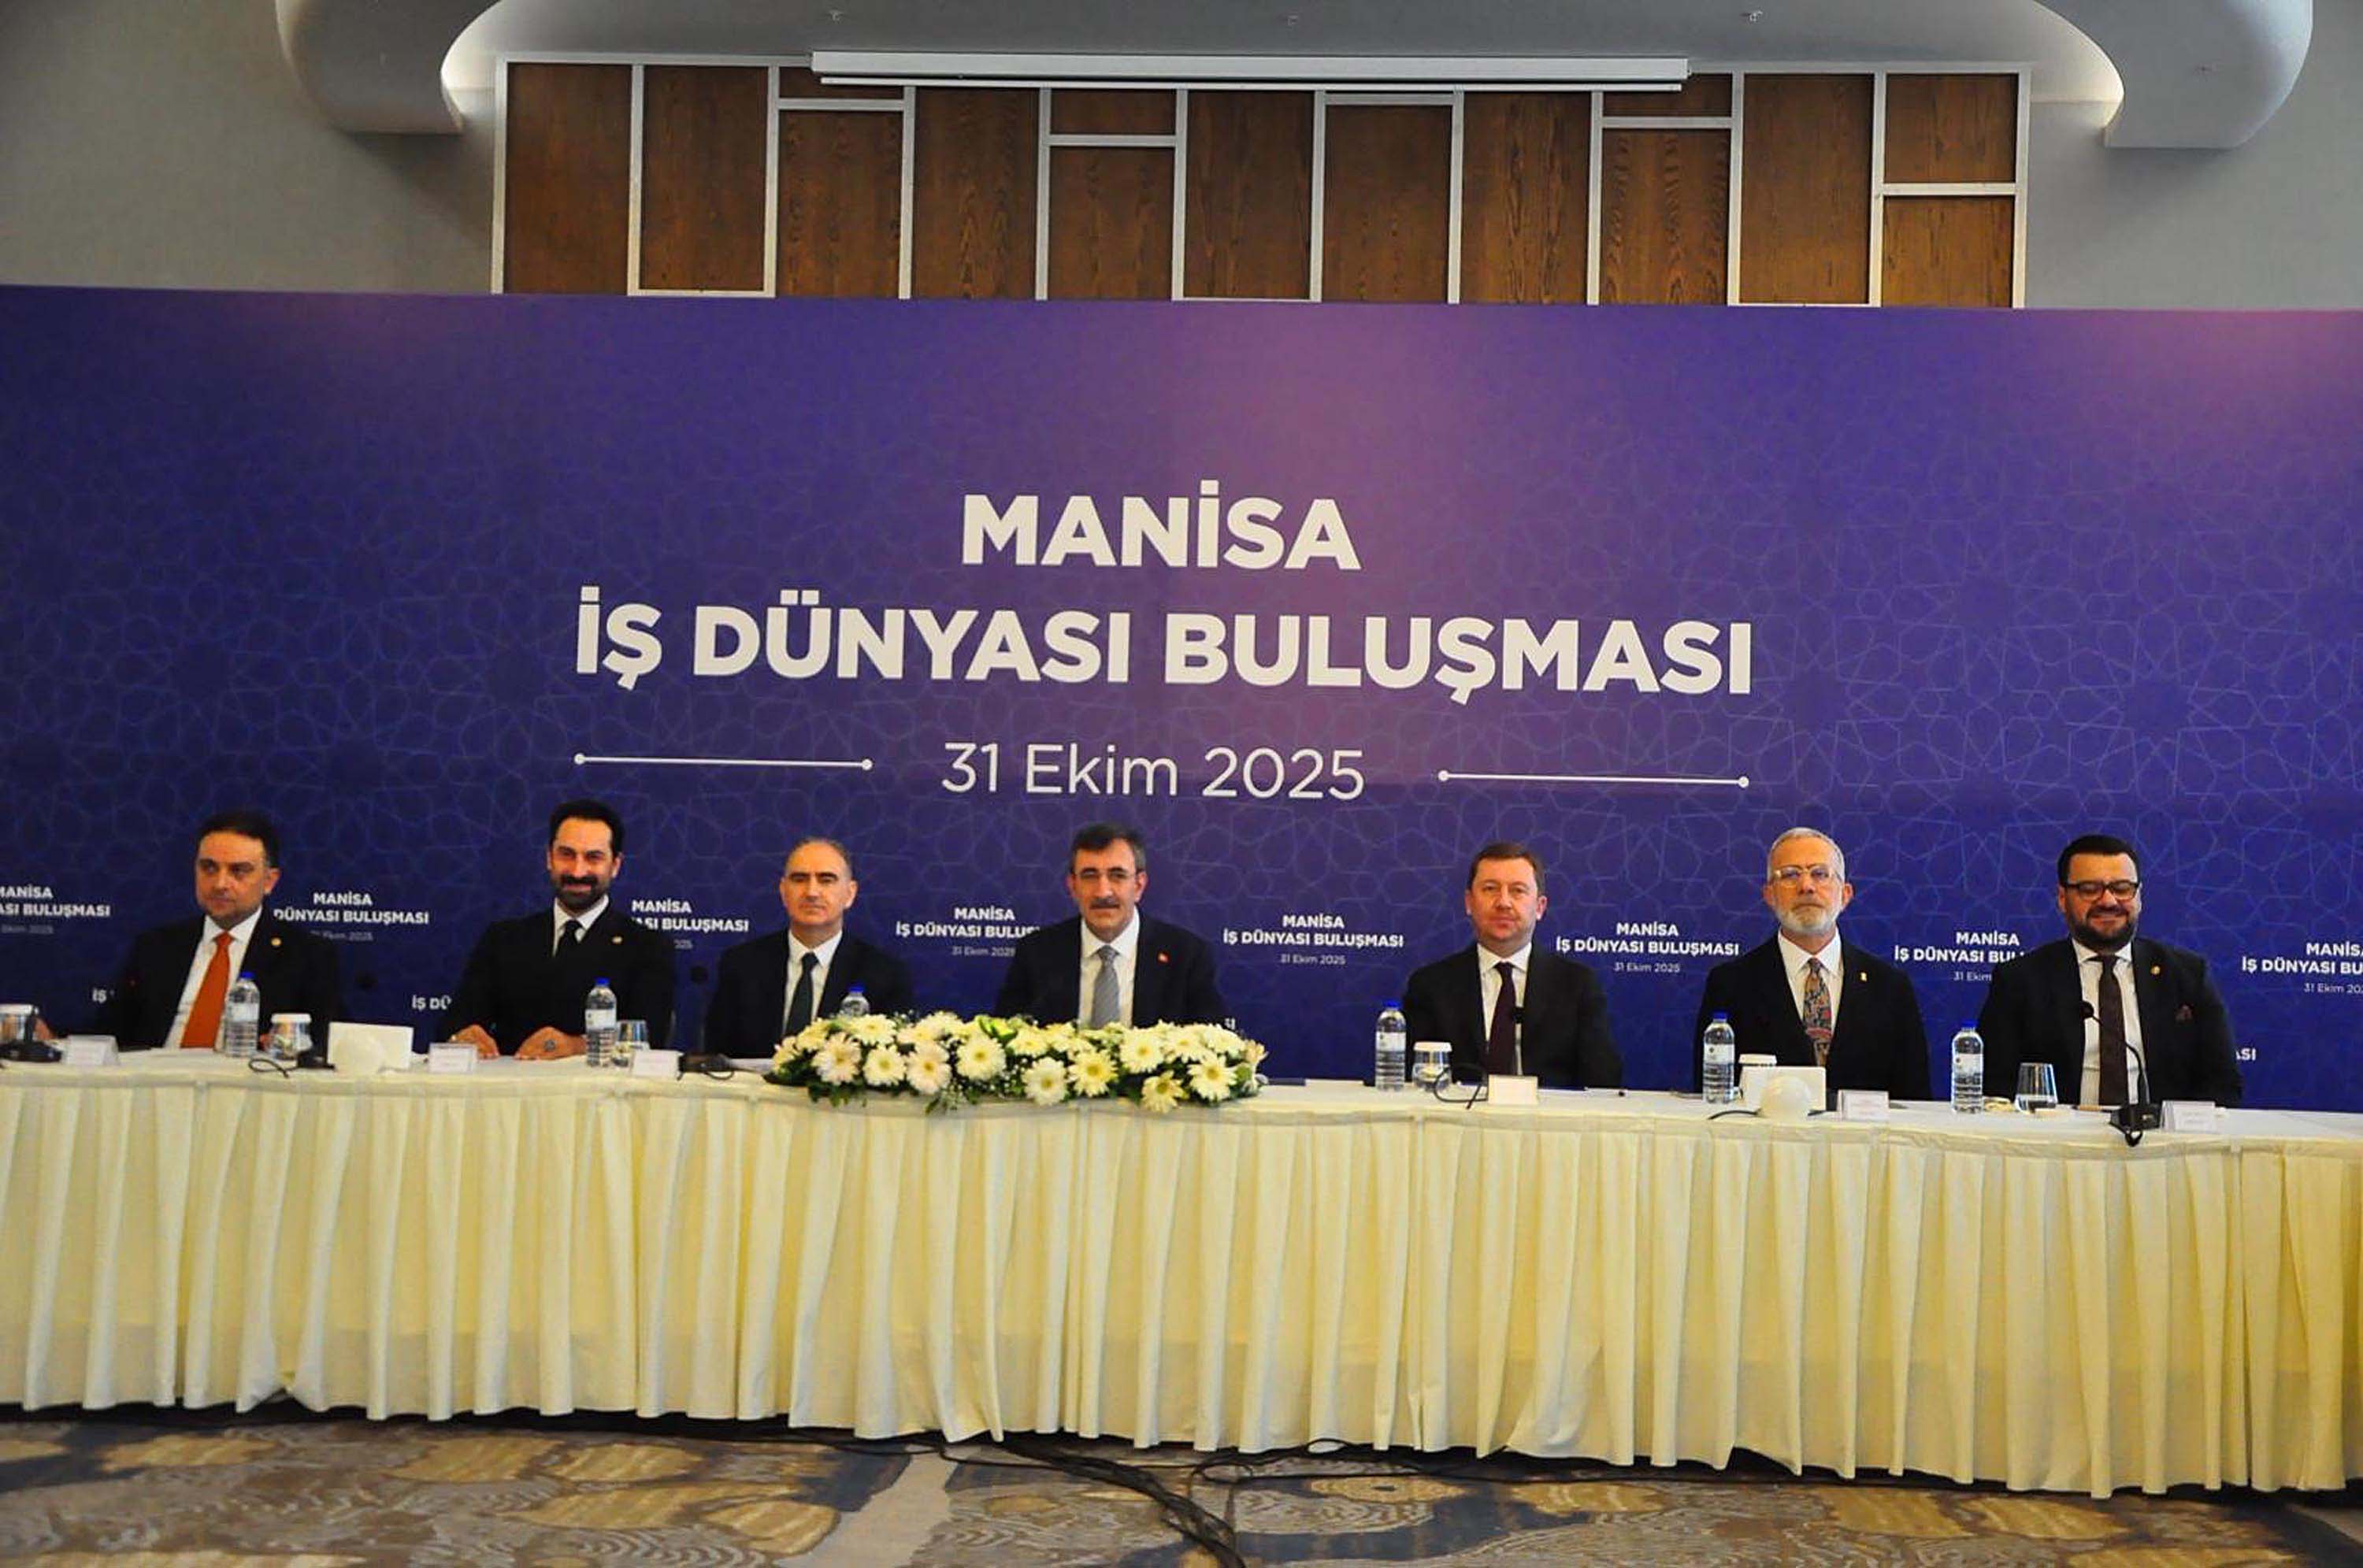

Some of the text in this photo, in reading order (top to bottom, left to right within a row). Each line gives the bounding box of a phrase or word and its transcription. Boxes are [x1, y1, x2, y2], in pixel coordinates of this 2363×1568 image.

[962, 480, 1361, 569] MANİSA
[577, 586, 1751, 705] İŞ DÜNYASI BULUŞMASI
[942, 743, 1365, 800] 31 Ekim 2025
[313, 891, 373, 905] MANİSA
[632, 899, 692, 913] MANİSA
[23, 903, 110, 918] BULUŞMASI
[343, 910, 429, 925] BULUŞMASI
[955, 906, 1015, 921] MANİSA
[662, 917, 749, 933] BULUŞMASI
[896, 921, 911, 937] İŞ
[914, 923, 981, 937] DÜNYASI
[1282, 914, 1345, 928] MANİSA
[1616, 921, 1679, 936] MANİSA
[1223, 929, 1404, 948] İŞ DÜNYASI BULUŞMASI
[1956, 930, 2020, 945] MANİSA
[1556, 936, 1739, 956] İŞ DÜNYASI BULUŞMASI
[1894, 945, 1909, 962] İŞ
[1913, 947, 1984, 962] DÜNYASI
[2306, 941, 2363, 957] MANİS
[2242, 956, 2257, 973] İŞ
[2261, 956, 2335, 973] DÜNYASI
[412, 995, 426, 1011] İŞ
